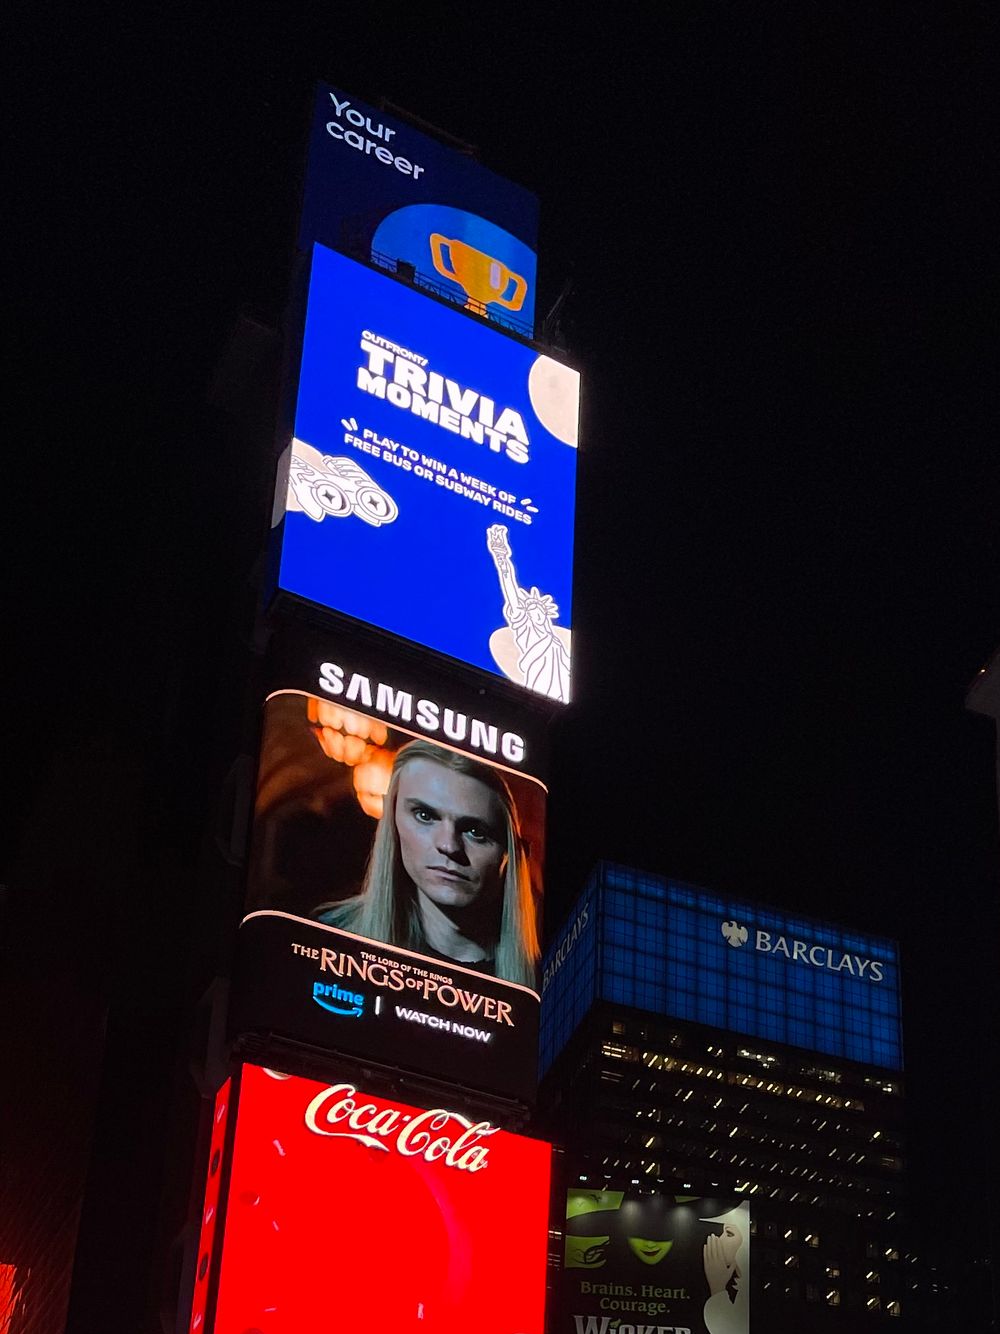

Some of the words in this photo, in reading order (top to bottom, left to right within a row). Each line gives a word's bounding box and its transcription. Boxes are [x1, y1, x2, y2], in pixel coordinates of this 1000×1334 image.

[328, 92, 397, 145] Your
[325, 120, 425, 181] career
[357, 366, 530, 464] MOMENTS
[360, 339, 530, 445] TRIVIA
[344, 433, 381, 458] FREE
[383, 450, 412, 472] BUS
[413, 465, 434, 482] OR
[435, 473, 491, 507] SUBWAY
[492, 499, 532, 525] RIDES
[363, 428, 401, 452] PLAY
[401, 445, 420, 462] TO
[421, 454, 447, 475] WIN
[448, 467, 459, 480] A
[460, 472, 497, 497] WEEK
[498, 490, 517, 505] OF
[319, 662, 525, 763] SAMSUNG
[361, 951, 377, 962] THE
[378, 956, 399, 969] LORD
[400, 962, 411, 973] OF
[412, 967, 428, 978] THE
[429, 971, 453, 985] RINGS
[543, 902, 590, 989] BARCLAYS
[756, 930, 884, 982] BARCLAYS
[291, 942, 319, 961] THE
[319, 947, 405, 991] RINGS
[405, 977, 424, 991] OF
[422, 978, 516, 1028] POWER
[313, 981, 364, 1006] prime
[394, 1005, 450, 1032] WATCH
[451, 1023, 492, 1043] NOW
[580, 1281, 637, 1297] Brains.
[641, 1285, 691, 1299] Heart.
[599, 1297, 670, 1316] Courage.
